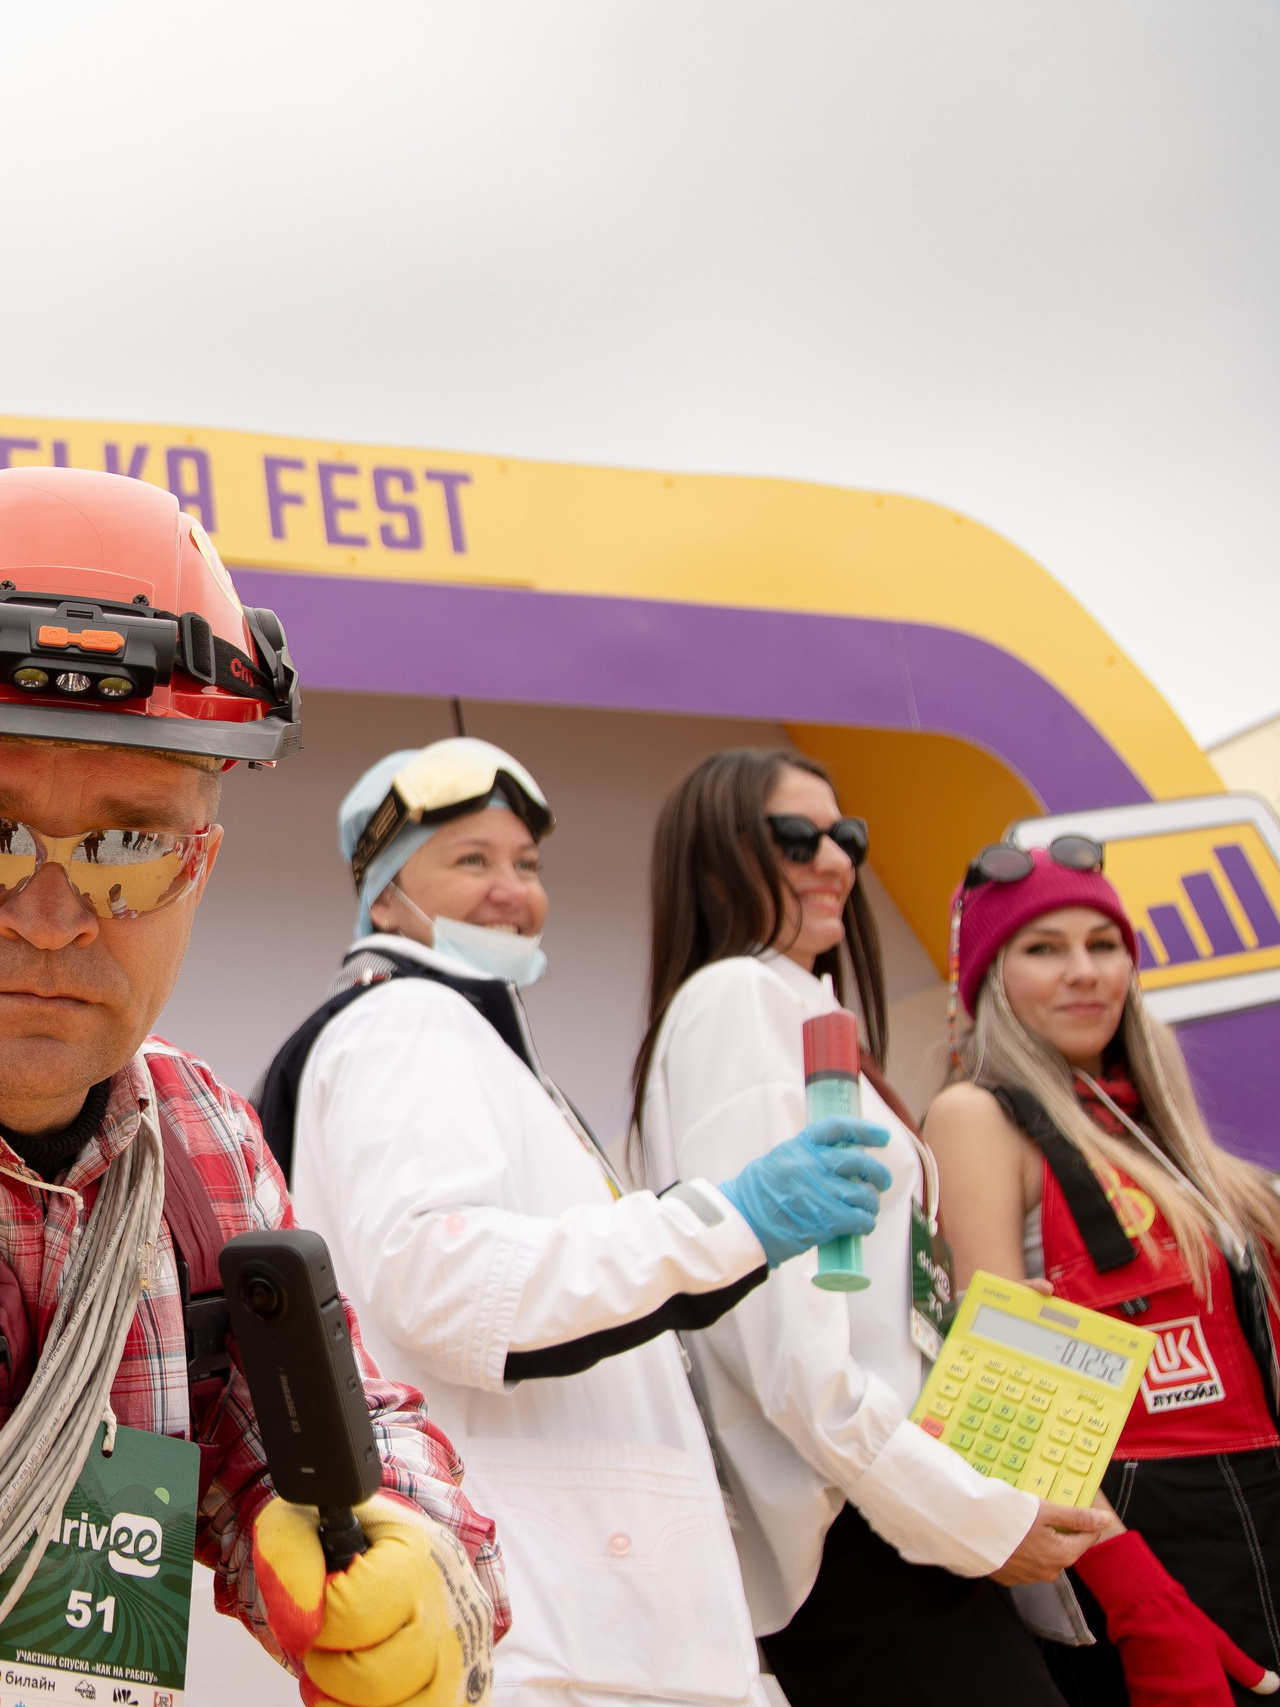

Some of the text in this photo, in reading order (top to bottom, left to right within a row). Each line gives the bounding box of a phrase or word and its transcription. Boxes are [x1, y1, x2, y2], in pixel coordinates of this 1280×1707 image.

[262, 454, 474, 555] FEST
[72, 1309, 80, 1325] UTP
[81, 1292, 91, 1307] cat
[1152, 1382, 1220, 1407] ЛУКОЙЛ
[12, 1453, 38, 1491] Premium
[65, 1589, 117, 1634] 51
[5, 1670, 56, 1692] билайн
[15, 1649, 159, 1684] УЧАСТНИК СПУСКА «КАК НА РАБОТУ»
